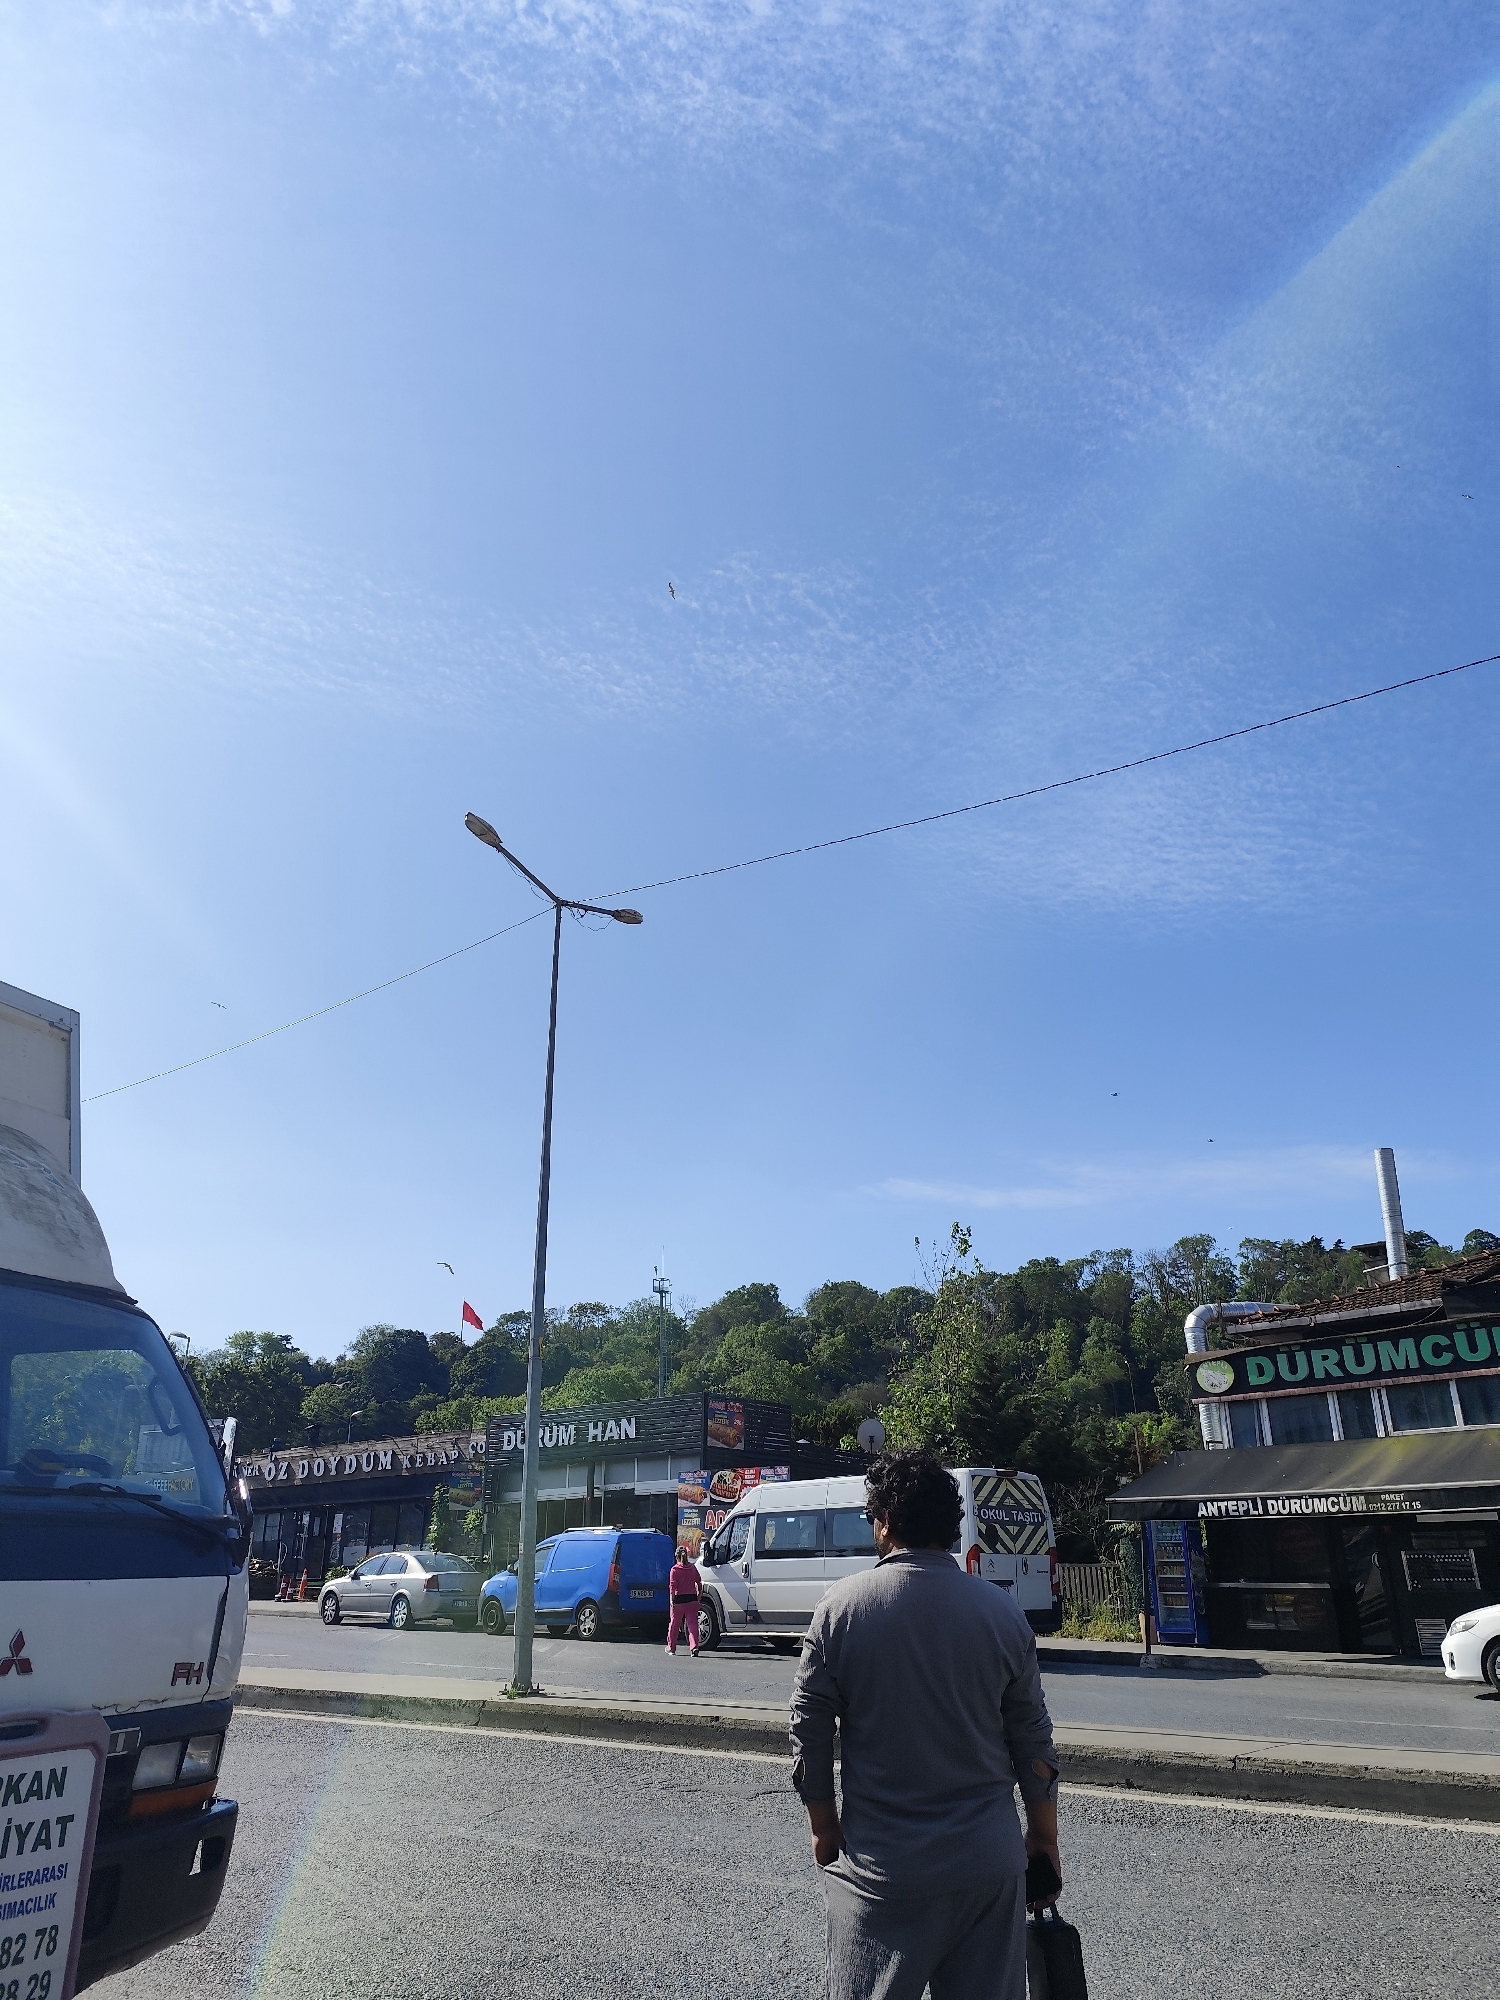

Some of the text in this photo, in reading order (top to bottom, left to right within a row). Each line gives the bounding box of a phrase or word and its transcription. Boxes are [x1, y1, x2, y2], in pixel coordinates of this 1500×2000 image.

[1246, 1321, 1500, 1386] DÜRÜMCÜ
[588, 1417, 636, 1443] HAN
[264, 1452, 289, 1481] ÖZ
[298, 1450, 393, 1479] DOYDUM
[402, 1449, 460, 1469] KEBAP
[1197, 1492, 1368, 1518] ANTEPLİ DÜRÜMCÜM
[1369, 1501, 1421, 1511] 0212 277 17 15
[1380, 1493, 1405, 1501] PAKET
[980, 1508, 1042, 1525] OKUL TAŞITI
[0, 1766, 68, 1808] KAN
[0, 1891, 58, 1921] IMACILIK
[0, 1924, 59, 1970] 82 78
[0, 1969, 52, 2000] 8 29
